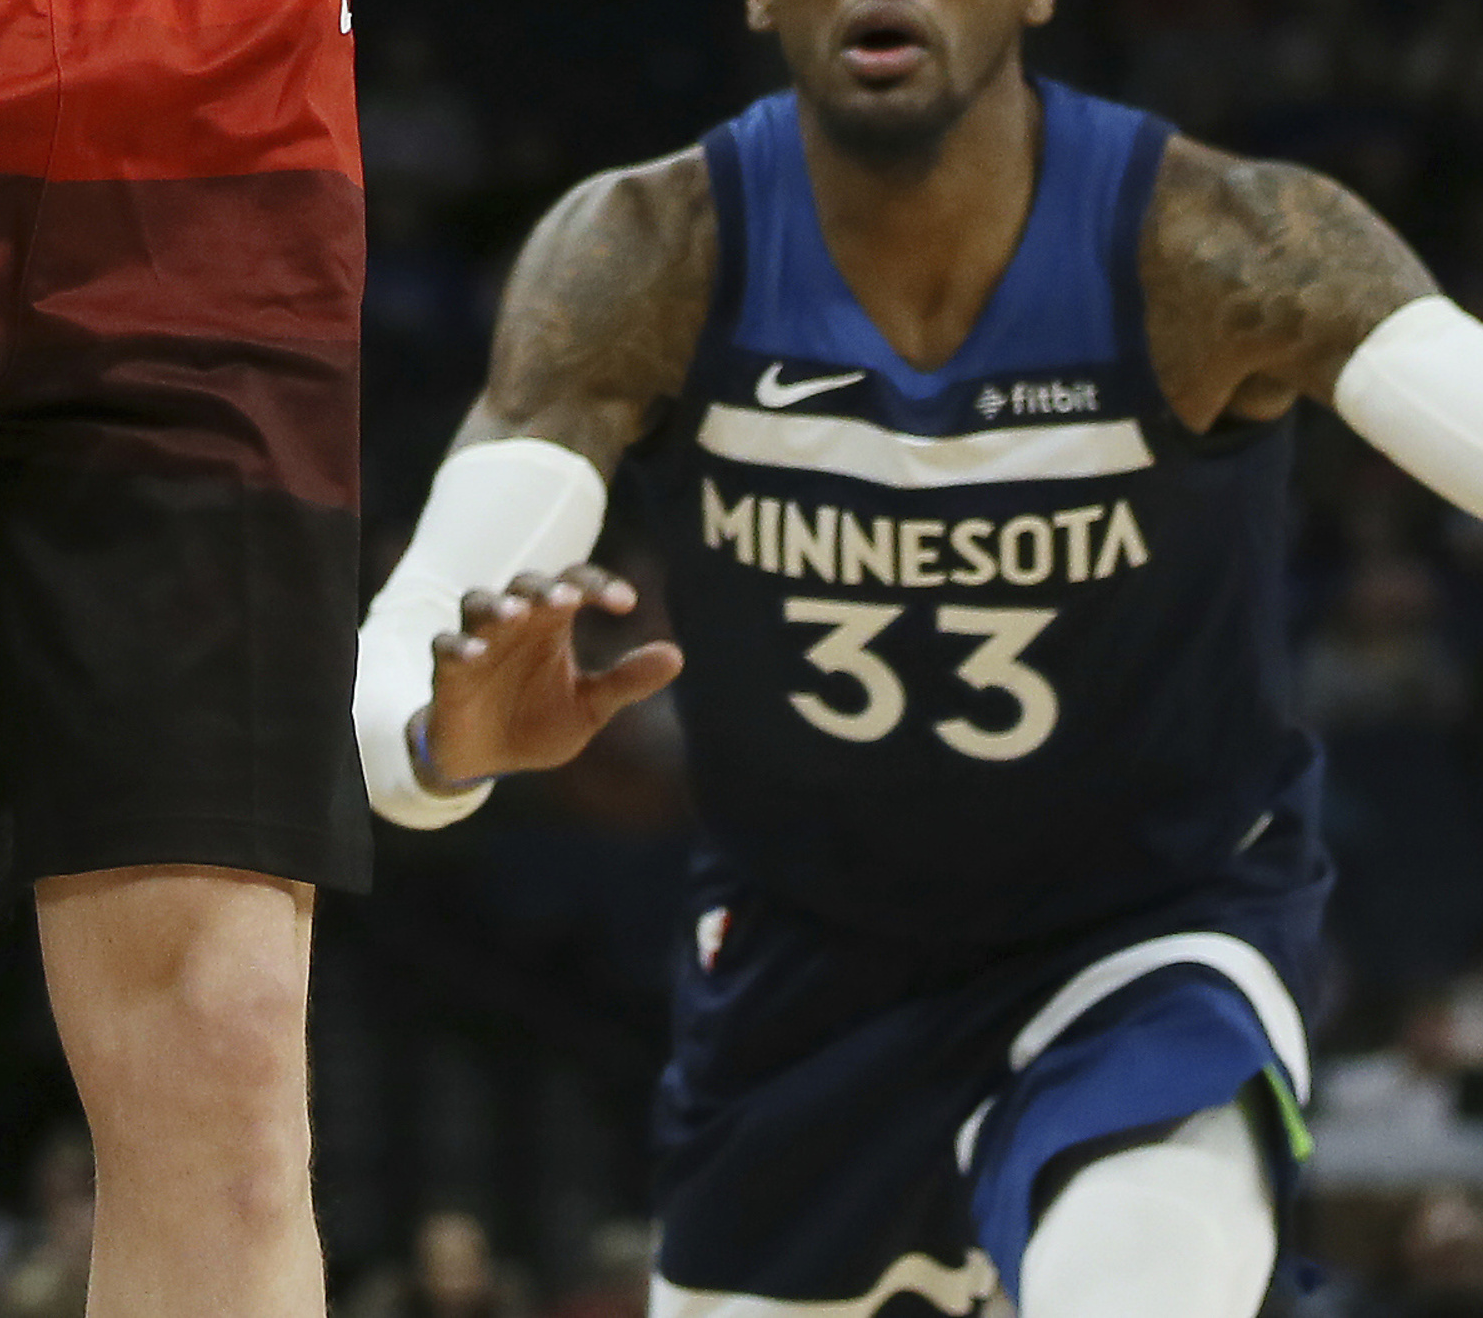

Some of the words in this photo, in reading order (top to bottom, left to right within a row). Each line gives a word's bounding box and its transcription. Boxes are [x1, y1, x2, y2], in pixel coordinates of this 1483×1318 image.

[1012, 381, 1100, 415] fitbit
[702, 478, 1150, 588] MINNESOTA
[783, 596, 1060, 762] 33
